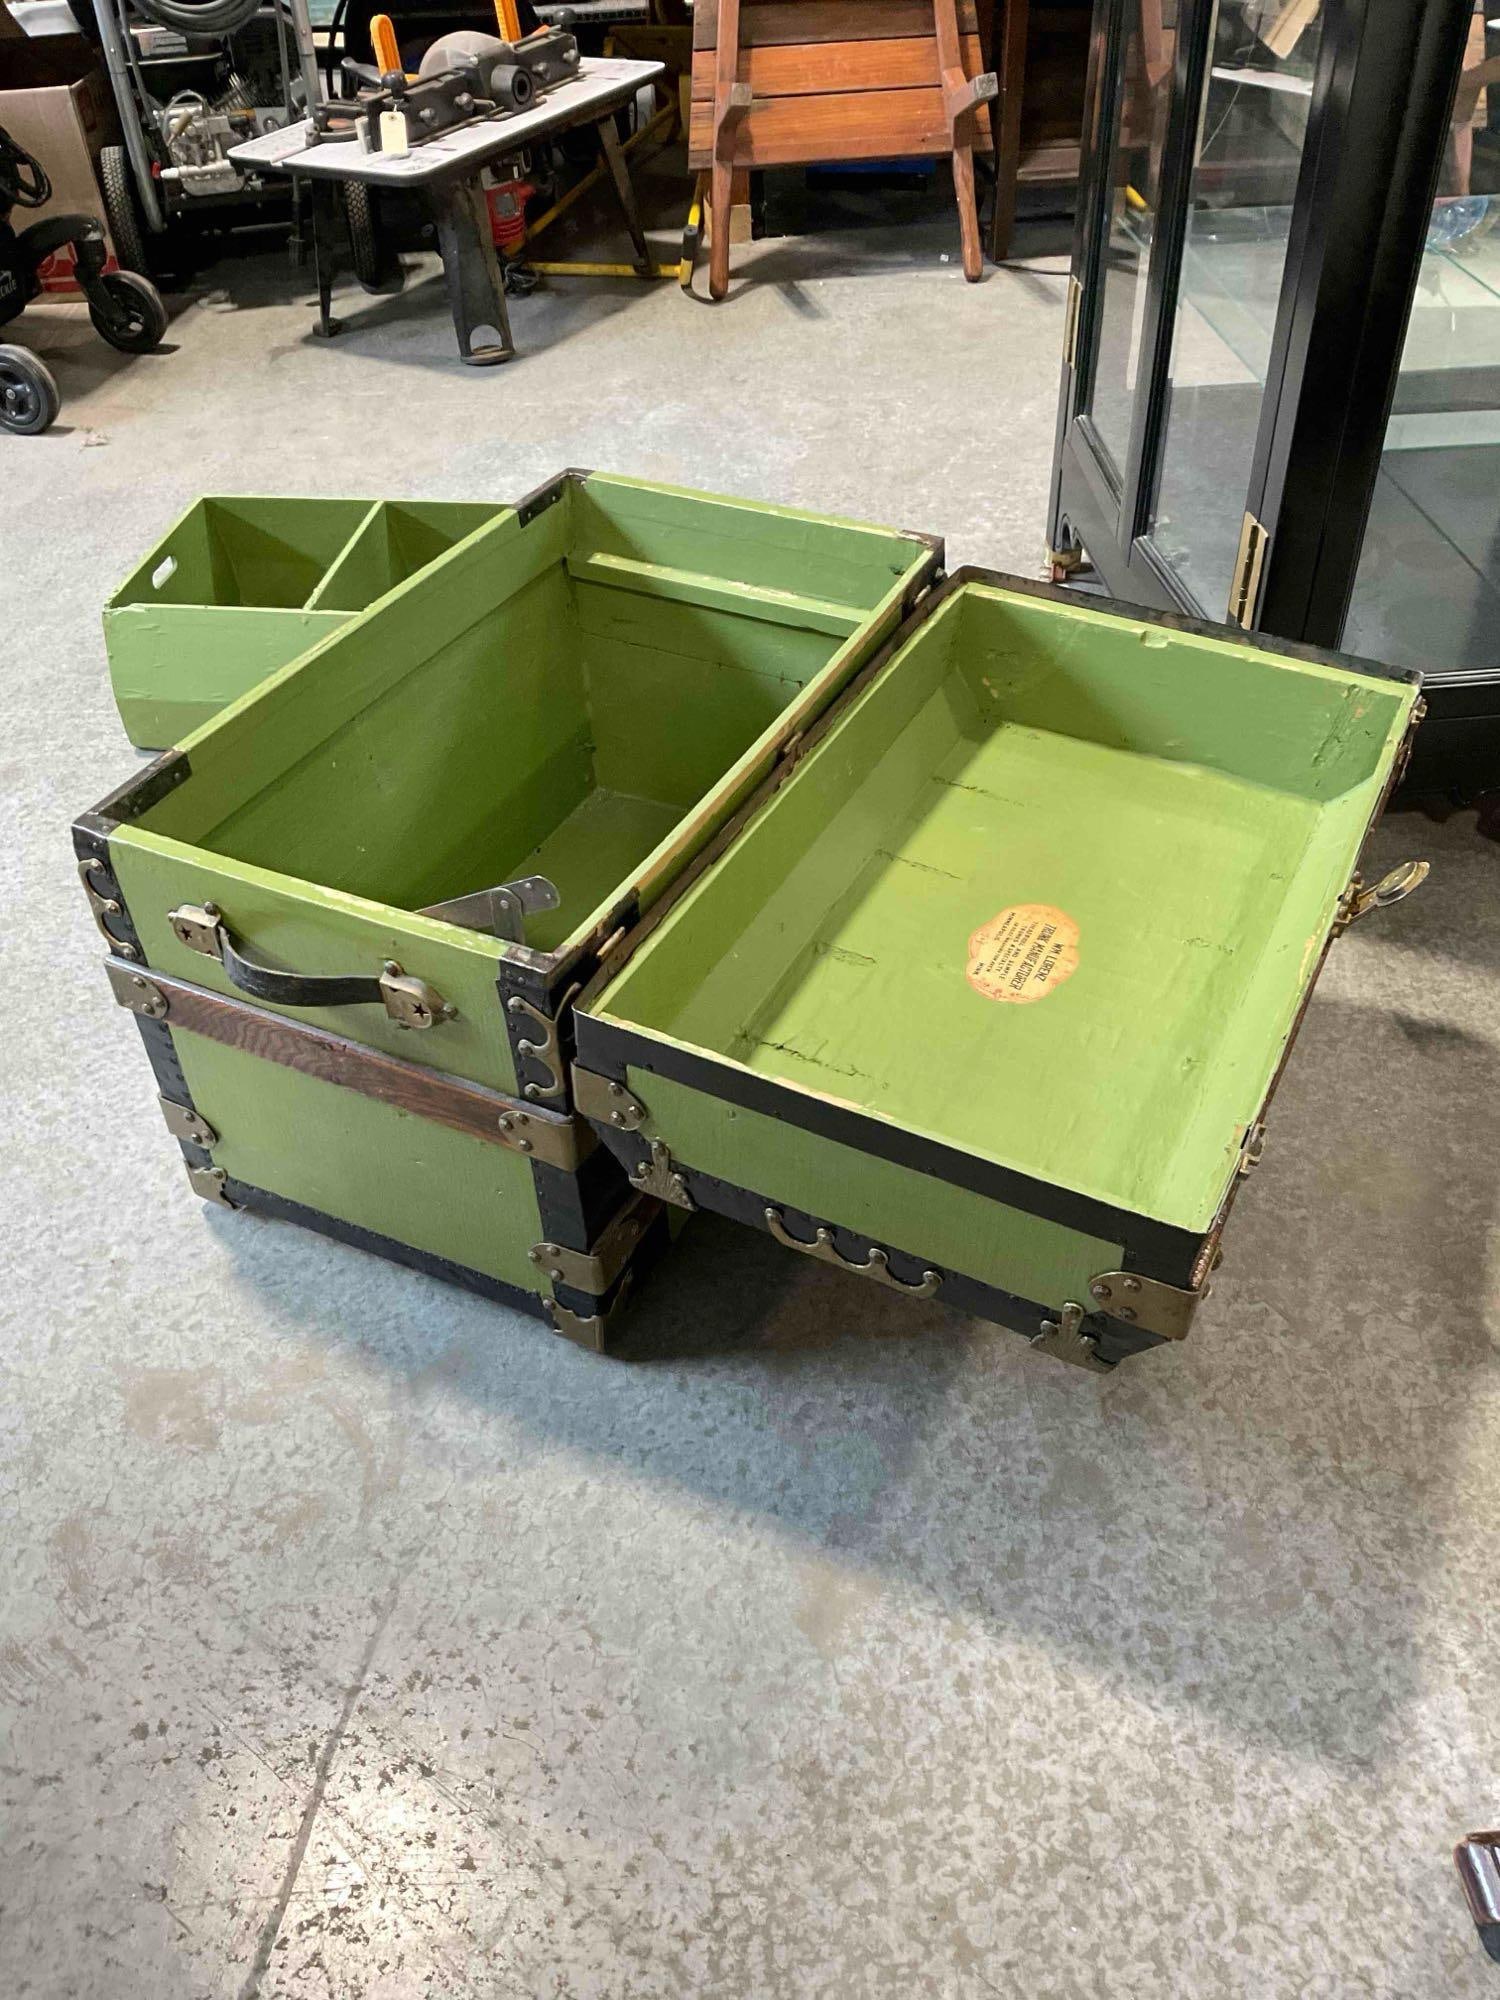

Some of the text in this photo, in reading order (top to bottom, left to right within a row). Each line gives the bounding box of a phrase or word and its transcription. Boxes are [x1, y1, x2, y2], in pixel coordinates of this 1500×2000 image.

[1036, 923, 1057, 944] TRUNK
[1008, 941, 1046, 991] MANUFACTURER
[1034, 954, 1058, 982] LORENZ
